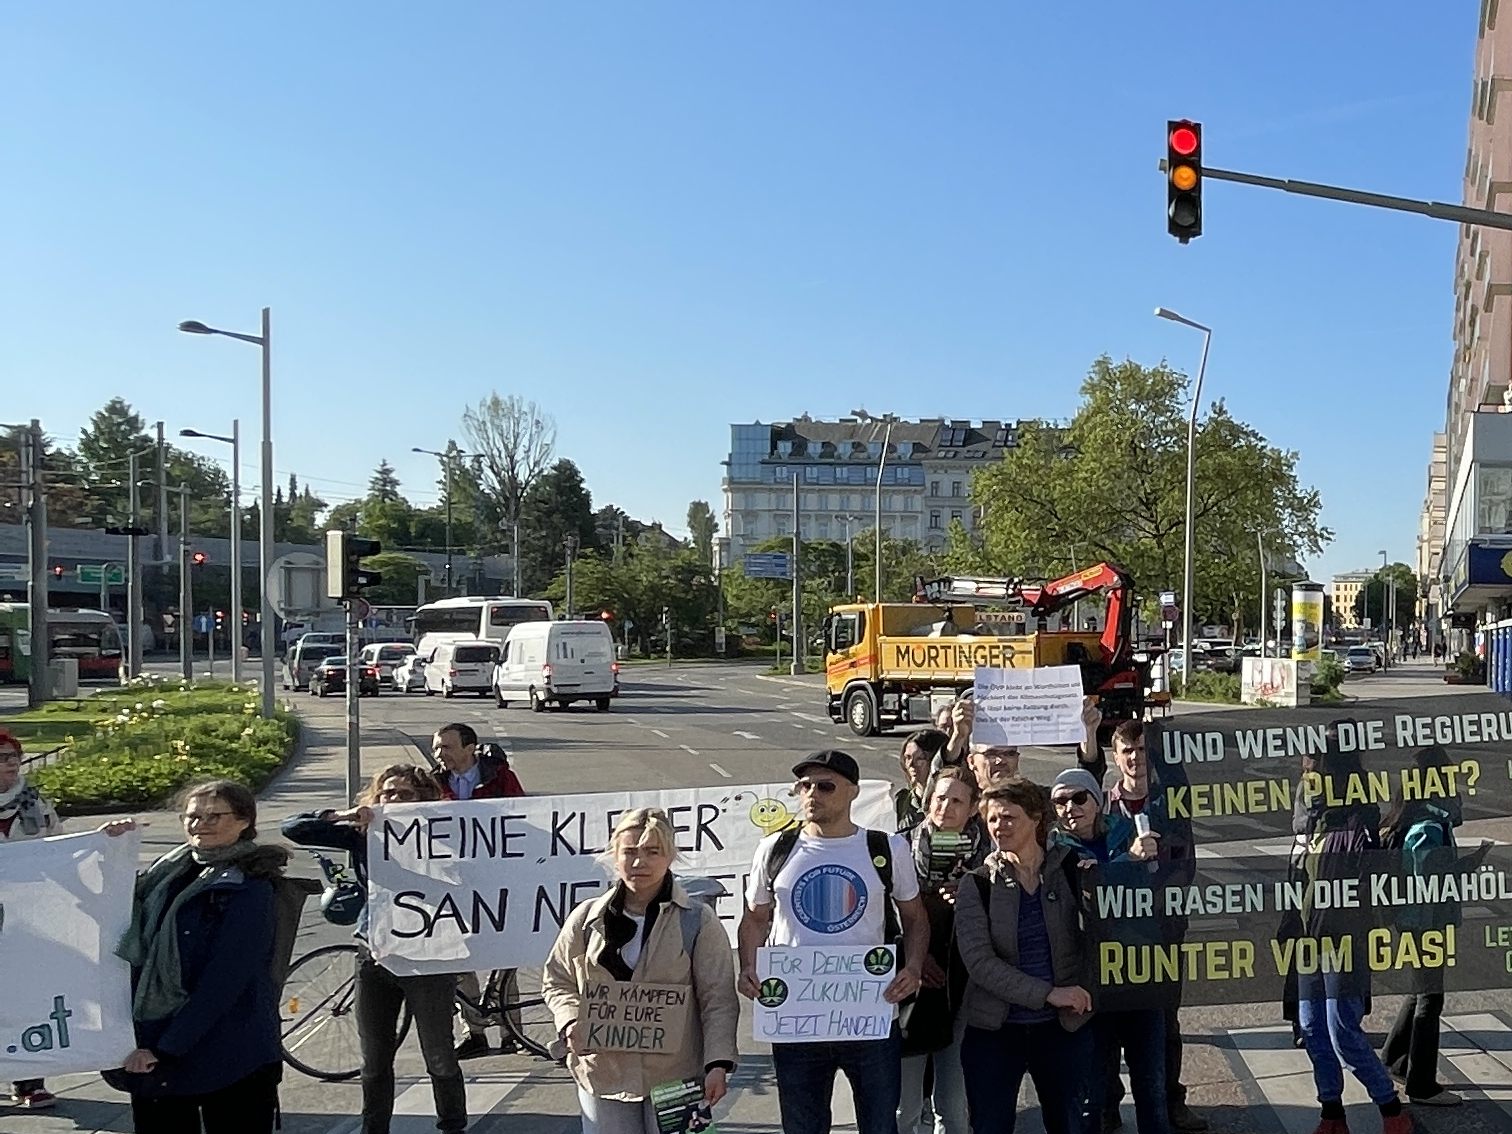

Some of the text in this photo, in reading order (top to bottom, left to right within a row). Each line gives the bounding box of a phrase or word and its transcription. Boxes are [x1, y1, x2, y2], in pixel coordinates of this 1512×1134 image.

[1162, 730, 1225, 765] UND
[1235, 724, 1328, 760] WENN
[1337, 720, 1386, 752] DIE
[1166, 759, 1481, 820] KEINEN PLAN HAT?
[383, 814, 527, 862] MEINE
[822, 866, 857, 881] FUTURE
[390, 887, 509, 938] SAN
[1096, 884, 1153, 919] WIR
[1164, 883, 1264, 916] RASEN
[1274, 881, 1303, 911] IN
[1313, 878, 1360, 909] DIE
[769, 950, 863, 976] FÜR DEINE
[1100, 923, 1457, 985] RUNTER VOM GAS!
[585, 984, 687, 1006] WIR KÄMPFEN
[796, 978, 888, 1003] ZUKUNFT
[587, 1001, 666, 1023] FÜR EURE
[762, 1009, 891, 1037] JETZT HANDELN
[586, 1022, 666, 1050] KINDER
